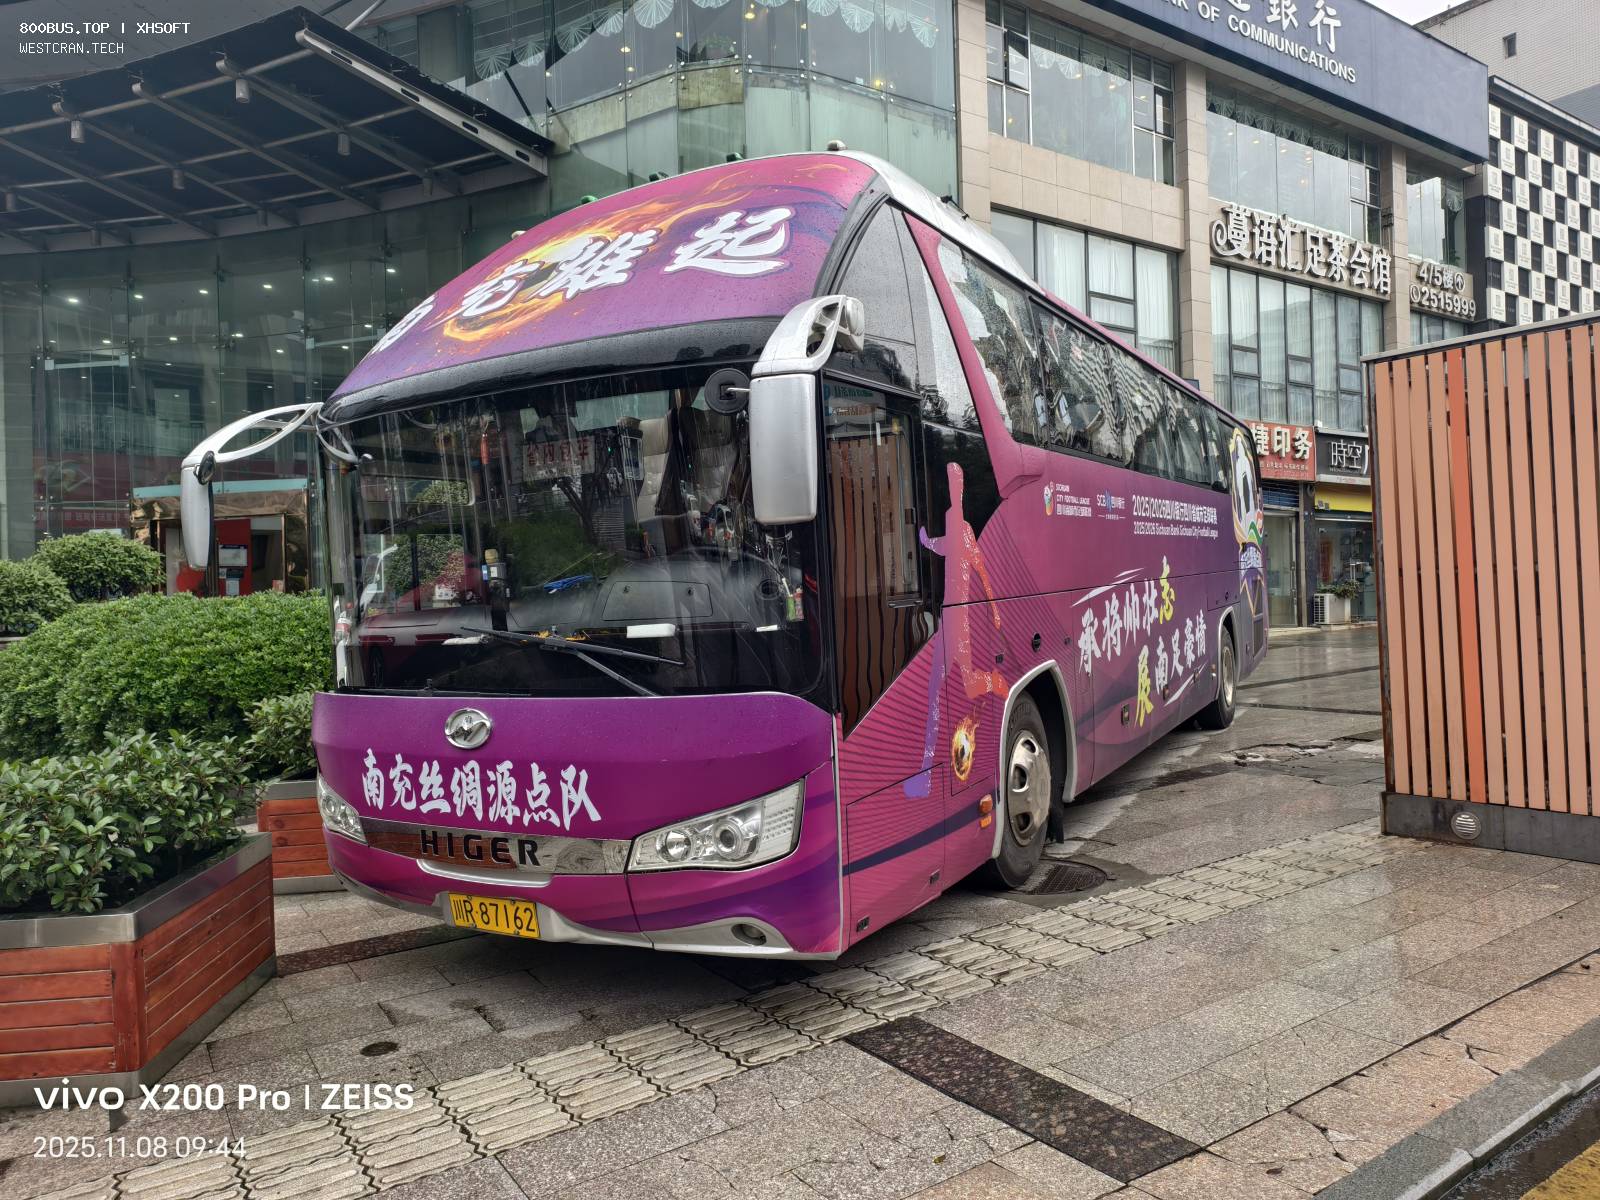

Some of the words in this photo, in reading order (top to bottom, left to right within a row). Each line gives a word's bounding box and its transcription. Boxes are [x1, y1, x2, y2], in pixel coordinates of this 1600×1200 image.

[1197, 1, 1220, 22] OF
[1228, 14, 1356, 83] COMMUNICATIONS
[1227, 0, 1342, 53] 銀行
[1210, 204, 1392, 294] 蔓语汇足茶会馆
[1418, 262, 1454, 289] 4/5楼
[1421, 286, 1476, 318] 2515999
[1331, 439, 1369, 474] 時空
[361, 748, 602, 831] 南充丝绸源点队
[419, 829, 542, 867] HIGER
